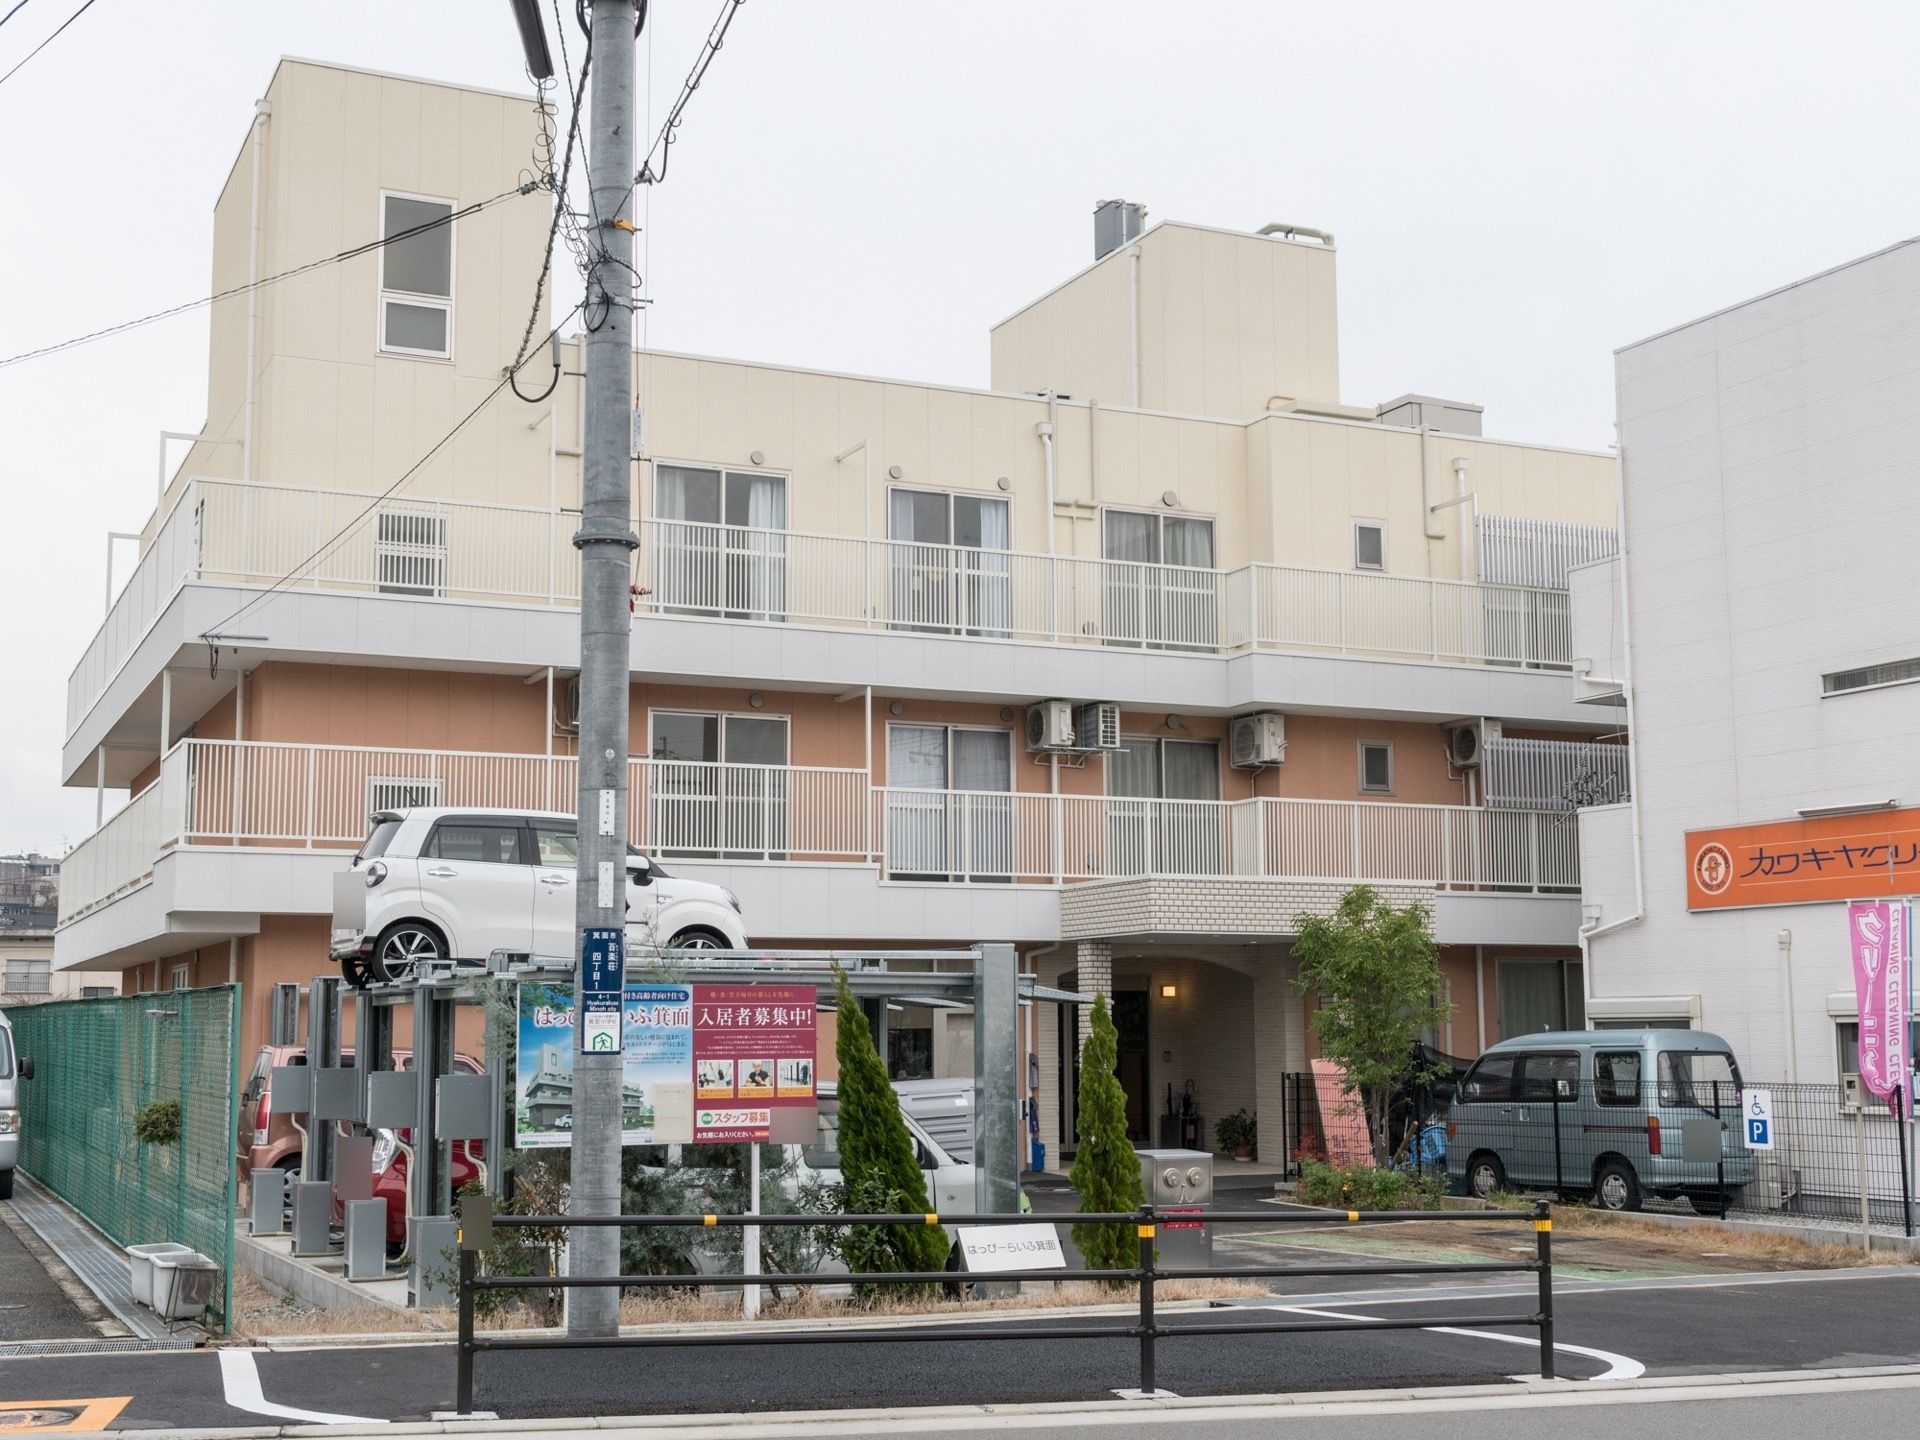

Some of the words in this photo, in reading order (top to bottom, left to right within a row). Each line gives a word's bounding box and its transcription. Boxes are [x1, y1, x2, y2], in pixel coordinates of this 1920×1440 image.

[714, 1112, 769, 1123] スタッフ募集
[1754, 1122, 1764, 1141] P
[967, 1240, 1056, 1255] はっぴーらいふ箕面
